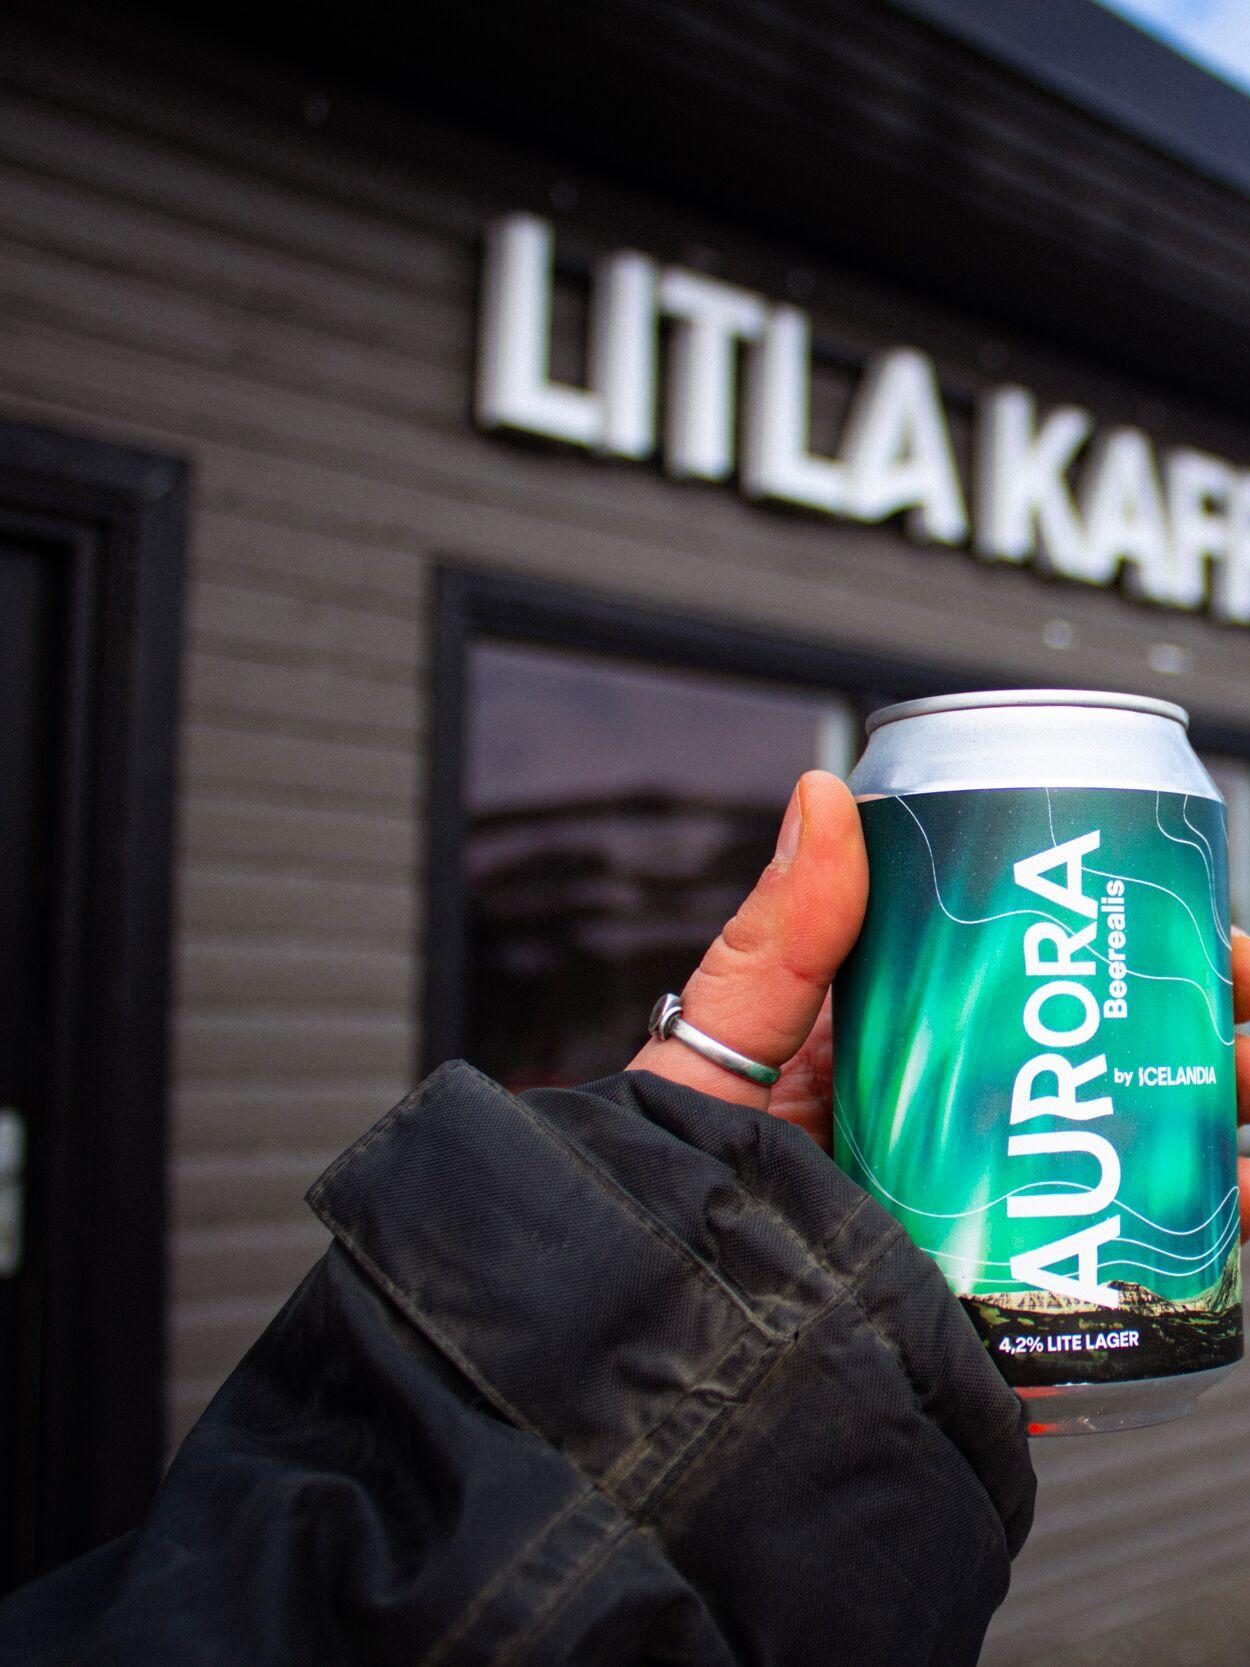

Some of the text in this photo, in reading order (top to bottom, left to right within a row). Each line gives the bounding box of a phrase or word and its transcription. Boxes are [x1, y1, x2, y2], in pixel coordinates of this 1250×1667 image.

[479, 212, 970, 546] LITLA
[1100, 879, 1128, 1019] Beerealis
[1006, 829, 1122, 1310] AURORA
[1113, 1066, 1217, 1087] by ICELANDIA
[999, 1330, 1140, 1355] 4,2% LITE LAGER
